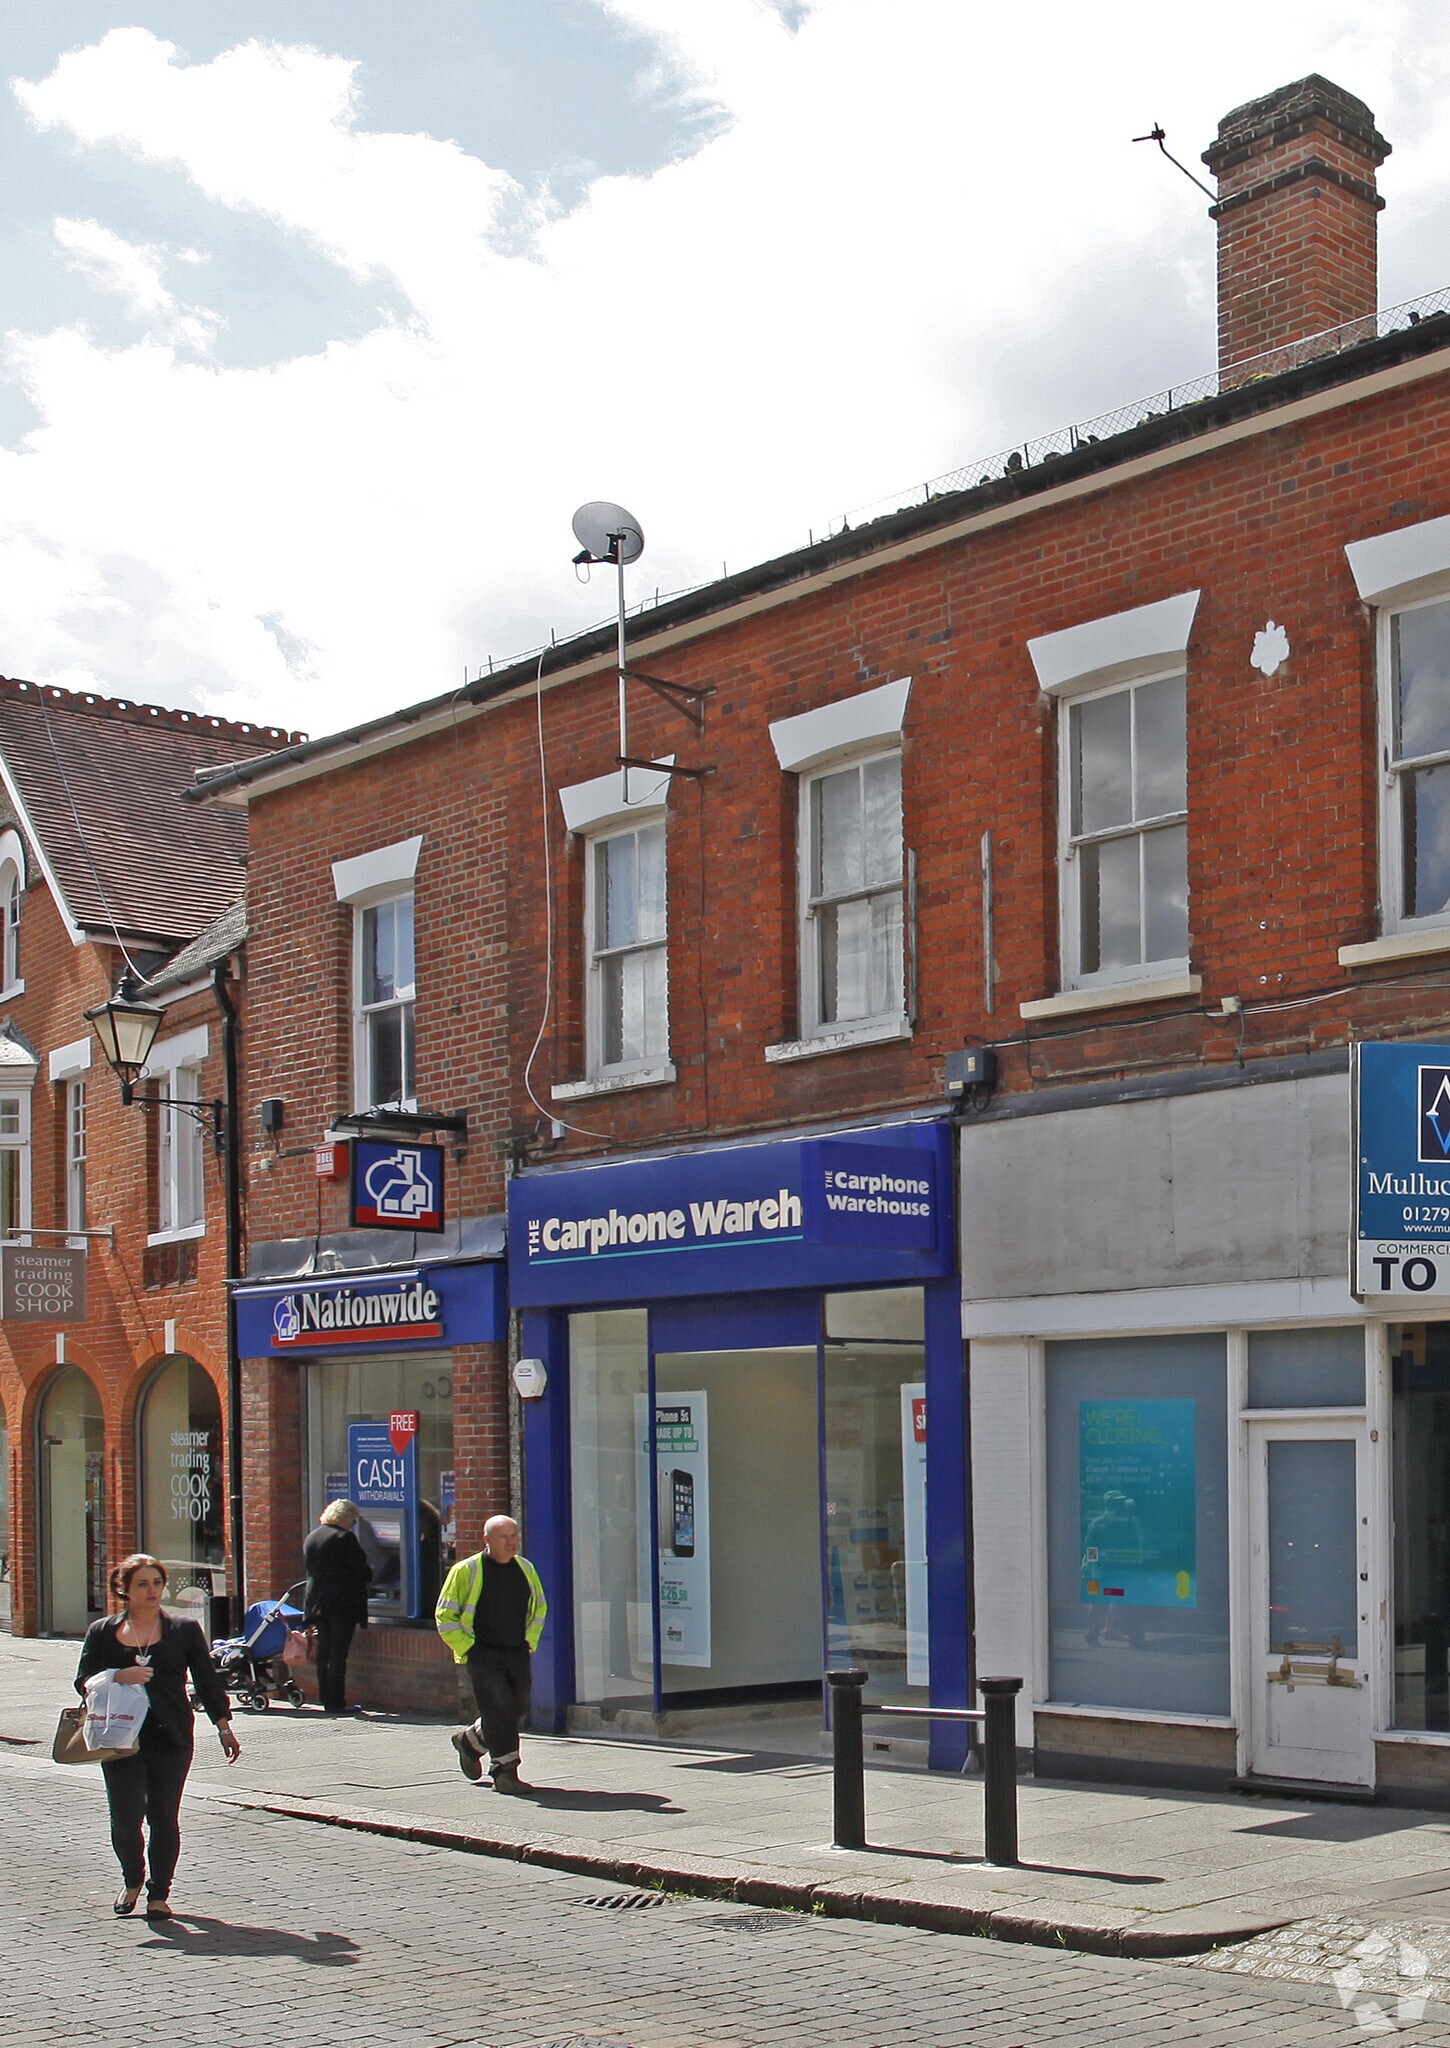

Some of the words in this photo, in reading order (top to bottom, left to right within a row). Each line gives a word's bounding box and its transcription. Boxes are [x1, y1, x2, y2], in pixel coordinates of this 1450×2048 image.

[824, 1170, 833, 1188] THE
[834, 1171, 930, 1195] Carphone
[825, 1194, 930, 1217] Warehouse
[1402, 1206, 1450, 1221] 01279
[528, 1219, 540, 1256] THE
[542, 1208, 686, 1255] Carphone
[689, 1188, 803, 1237] Wareh
[1376, 1243, 1450, 1255] COMMERCI
[14, 1255, 73, 1267] steamer
[14, 1267, 73, 1285] trading
[1372, 1257, 1437, 1292] TO
[15, 1282, 73, 1298] COOK
[15, 1298, 74, 1313] SHOP
[301, 1282, 437, 1330] Nationwide
[390, 1414, 415, 1431] FREE
[656, 1410, 678, 1422] Phone
[170, 1430, 209, 1447] steamer
[171, 1447, 210, 1474] trading
[357, 1458, 405, 1488] CASH
[170, 1474, 210, 1497] COOK
[358, 1490, 405, 1502] WITHDRAWALS
[171, 1498, 210, 1521] SHOP
